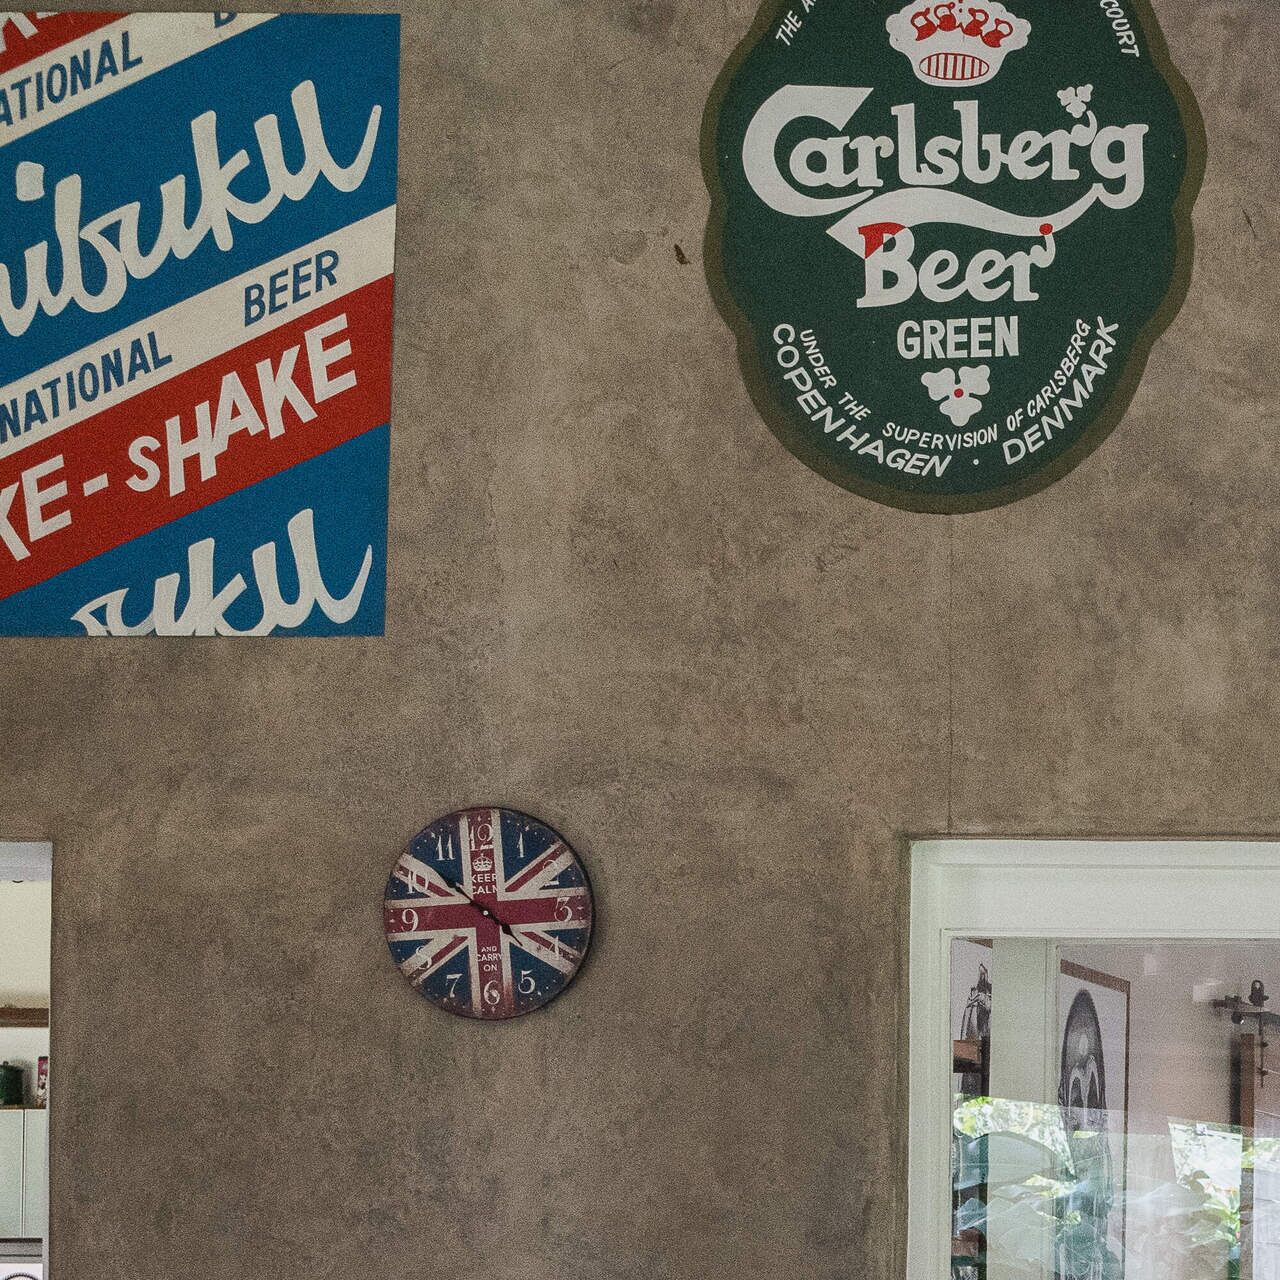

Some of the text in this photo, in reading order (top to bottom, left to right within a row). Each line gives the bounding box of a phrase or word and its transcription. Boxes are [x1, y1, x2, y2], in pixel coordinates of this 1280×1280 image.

[774, 10, 803, 46] THE
[1100, 0, 1140, 58] COURT
[742, 84, 1149, 217] Carlsberg
[856, 222, 1057, 309] Beer
[243, 249, 340, 328] BEER
[896, 315, 1019, 360] GREEN
[0, 331, 173, 444] NATIONAL
[773, 316, 1120, 478] COPENHAGEN DENMARK
[800, 318, 1092, 452] UNDER THE SUPERVISION OF CARLSBERG
[436, 834, 456, 861] 11
[469, 823, 494, 852] 12
[401, 908, 419, 932] 9
[554, 896, 573, 923] 3
[446, 973, 463, 998] 7
[483, 964, 498, 972] ON
[518, 969, 536, 994] 5
[483, 980, 501, 1005] 6
